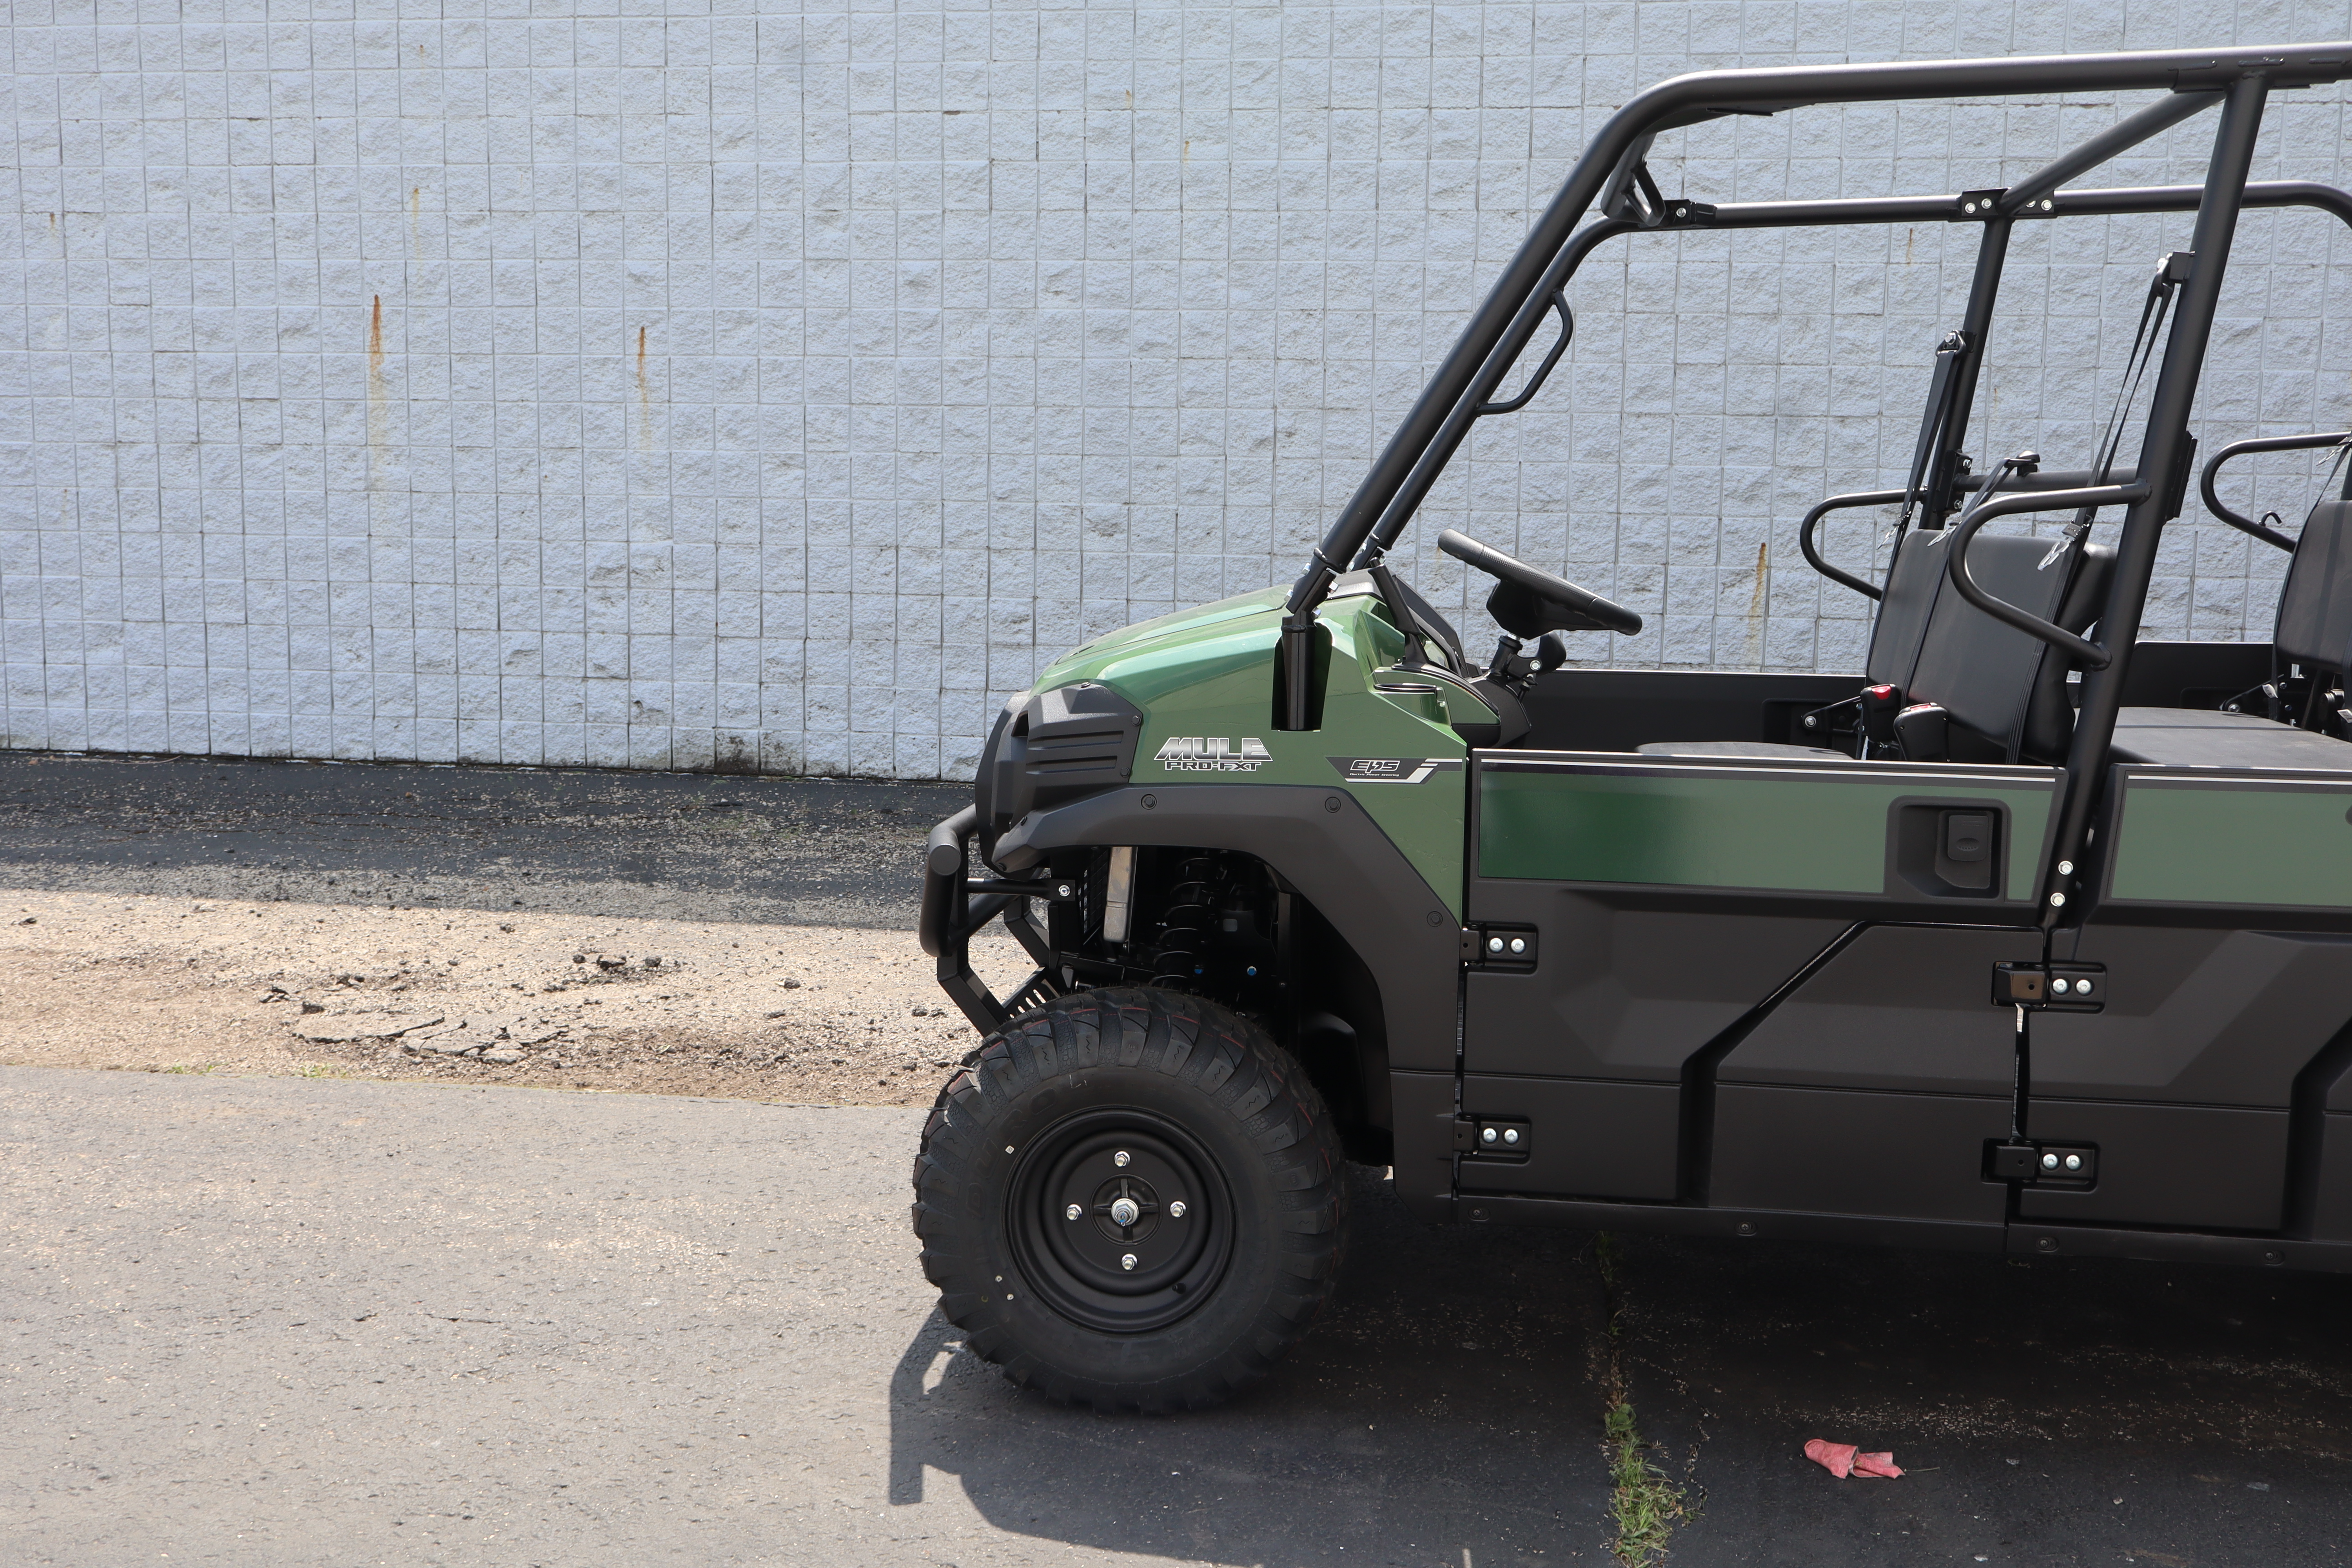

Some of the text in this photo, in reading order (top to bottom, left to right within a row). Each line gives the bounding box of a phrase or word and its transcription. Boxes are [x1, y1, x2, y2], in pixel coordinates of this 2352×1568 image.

[1154, 737, 1273, 761] MULE
[1165, 761, 1262, 771] PRO-FXT
[1350, 760, 1401, 773] EPS
[965, 1087, 1056, 1220] DURO
